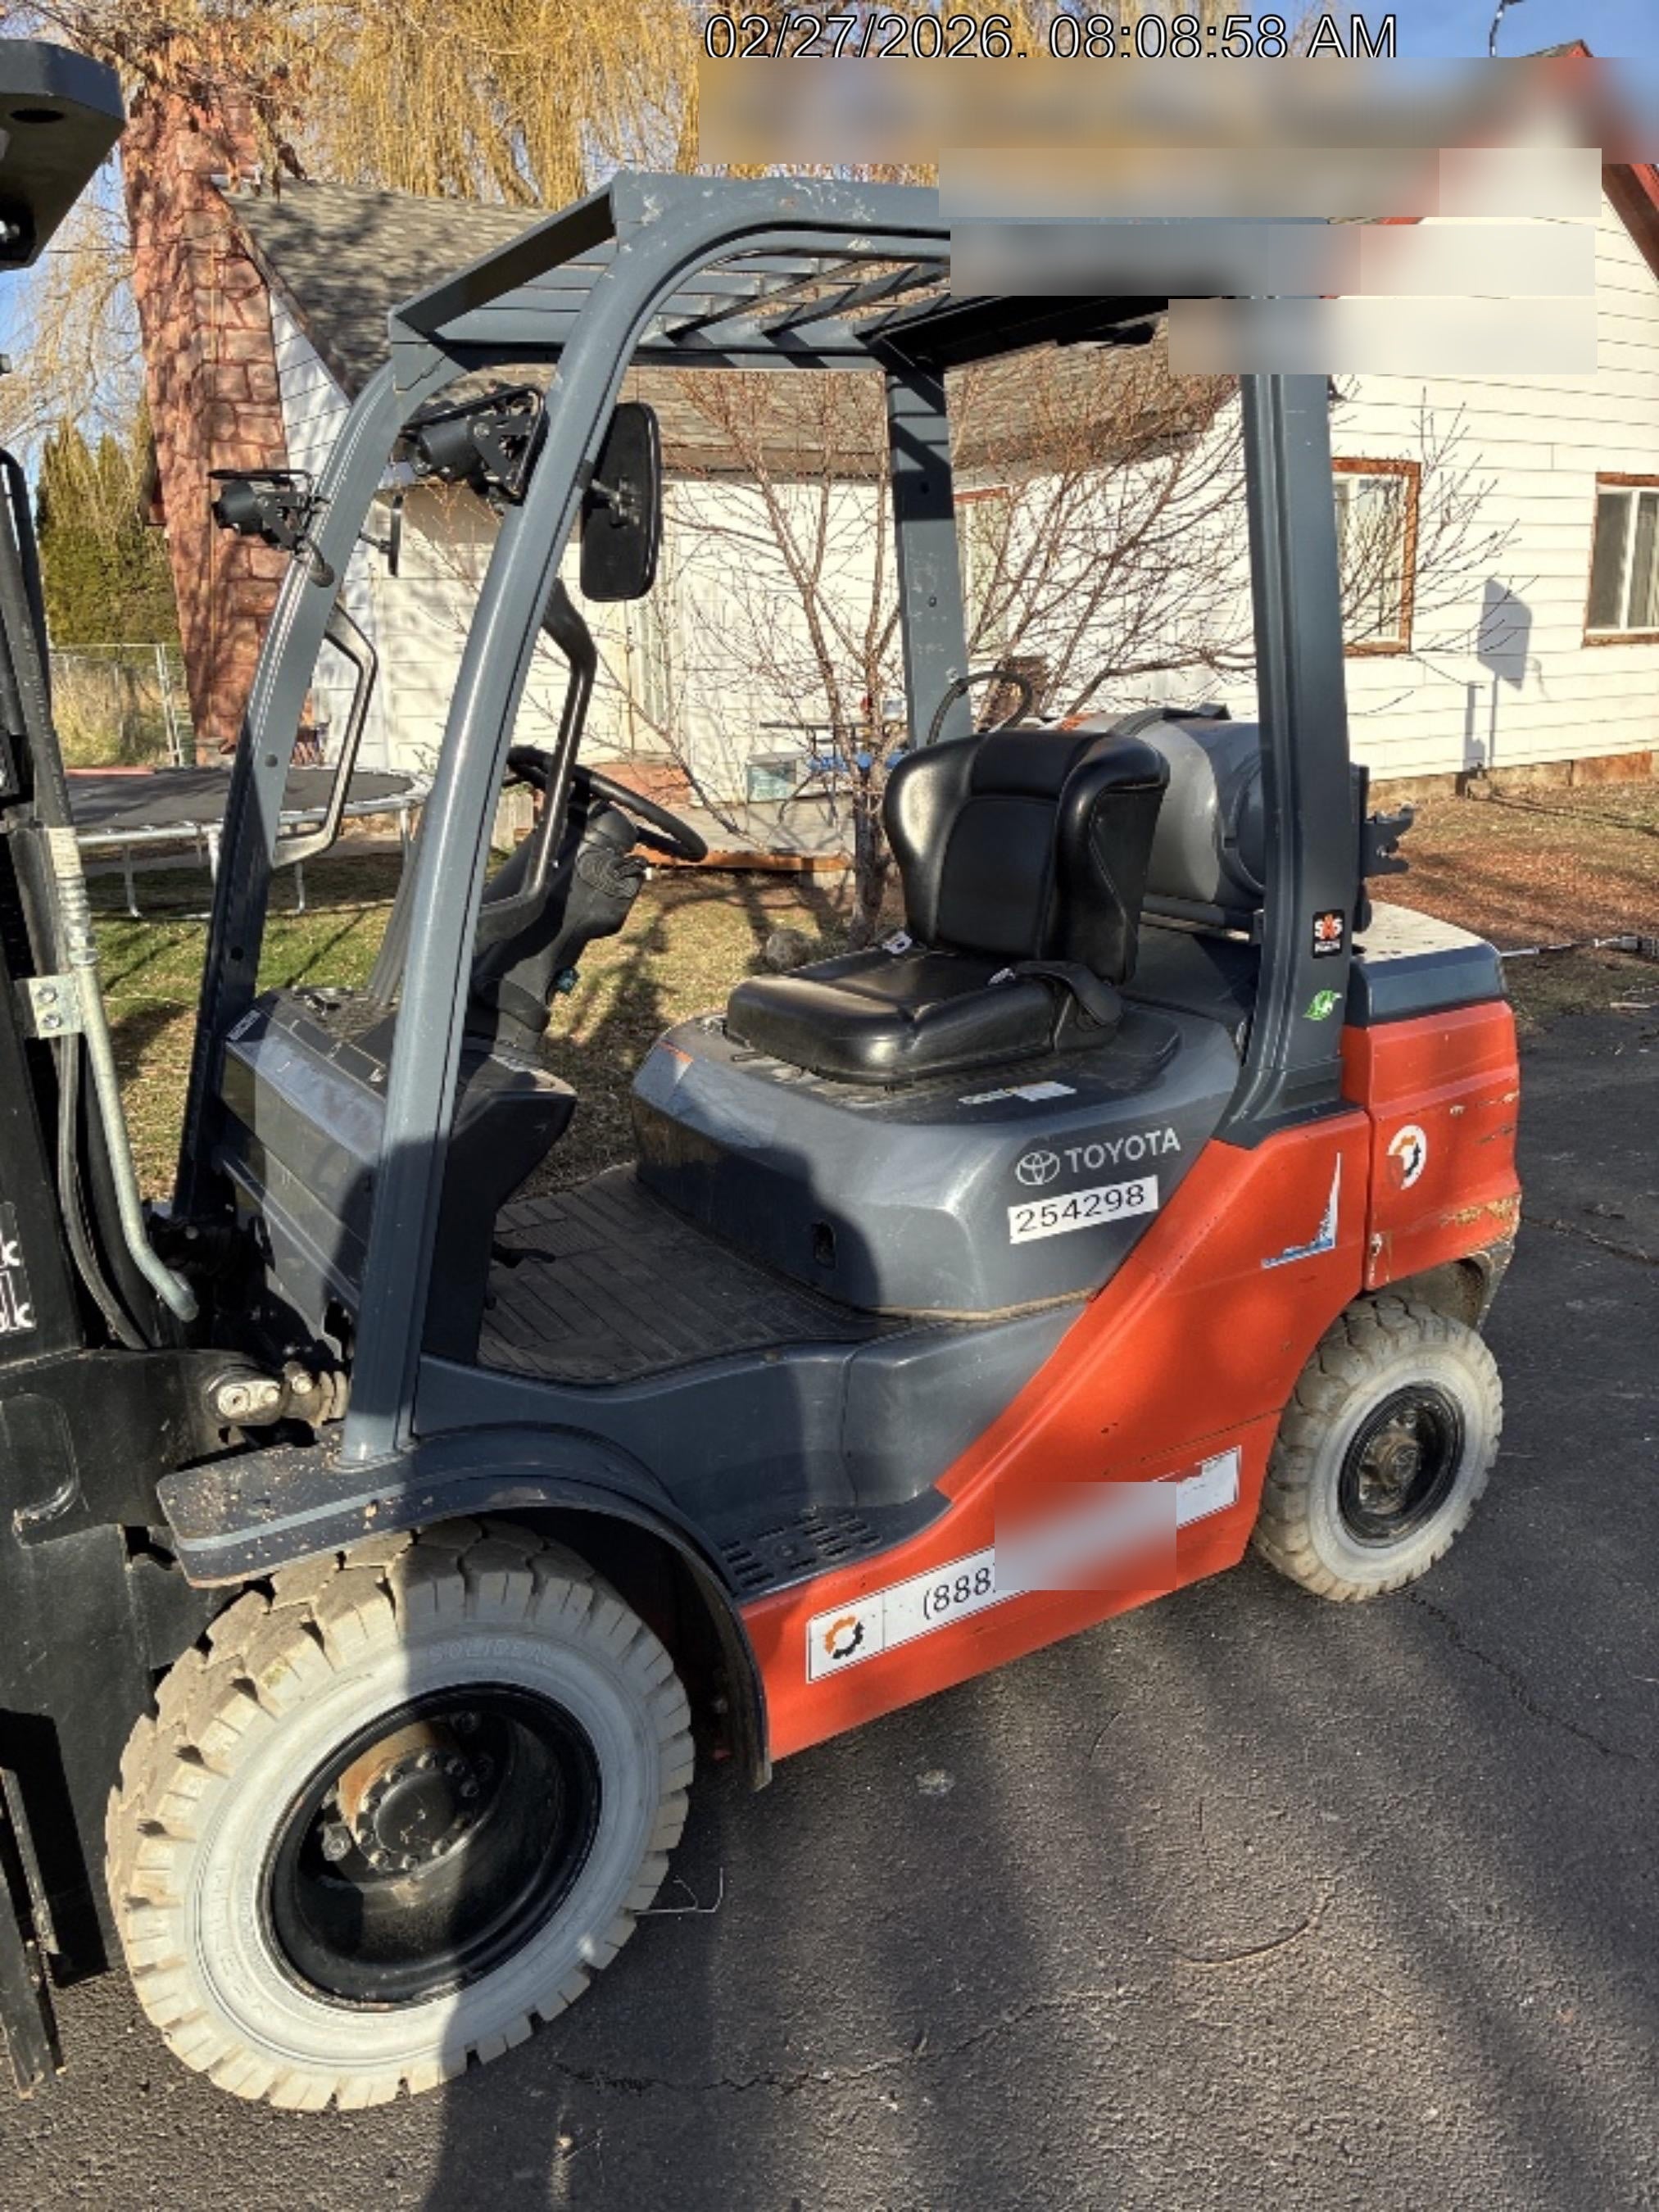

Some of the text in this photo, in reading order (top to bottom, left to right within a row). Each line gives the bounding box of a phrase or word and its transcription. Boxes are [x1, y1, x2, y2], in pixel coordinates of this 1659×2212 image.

[1065, 1127, 1181, 1172] TOYOTA
[1014, 1185, 1145, 1233] 254298
[923, 1563, 995, 1620] (888
